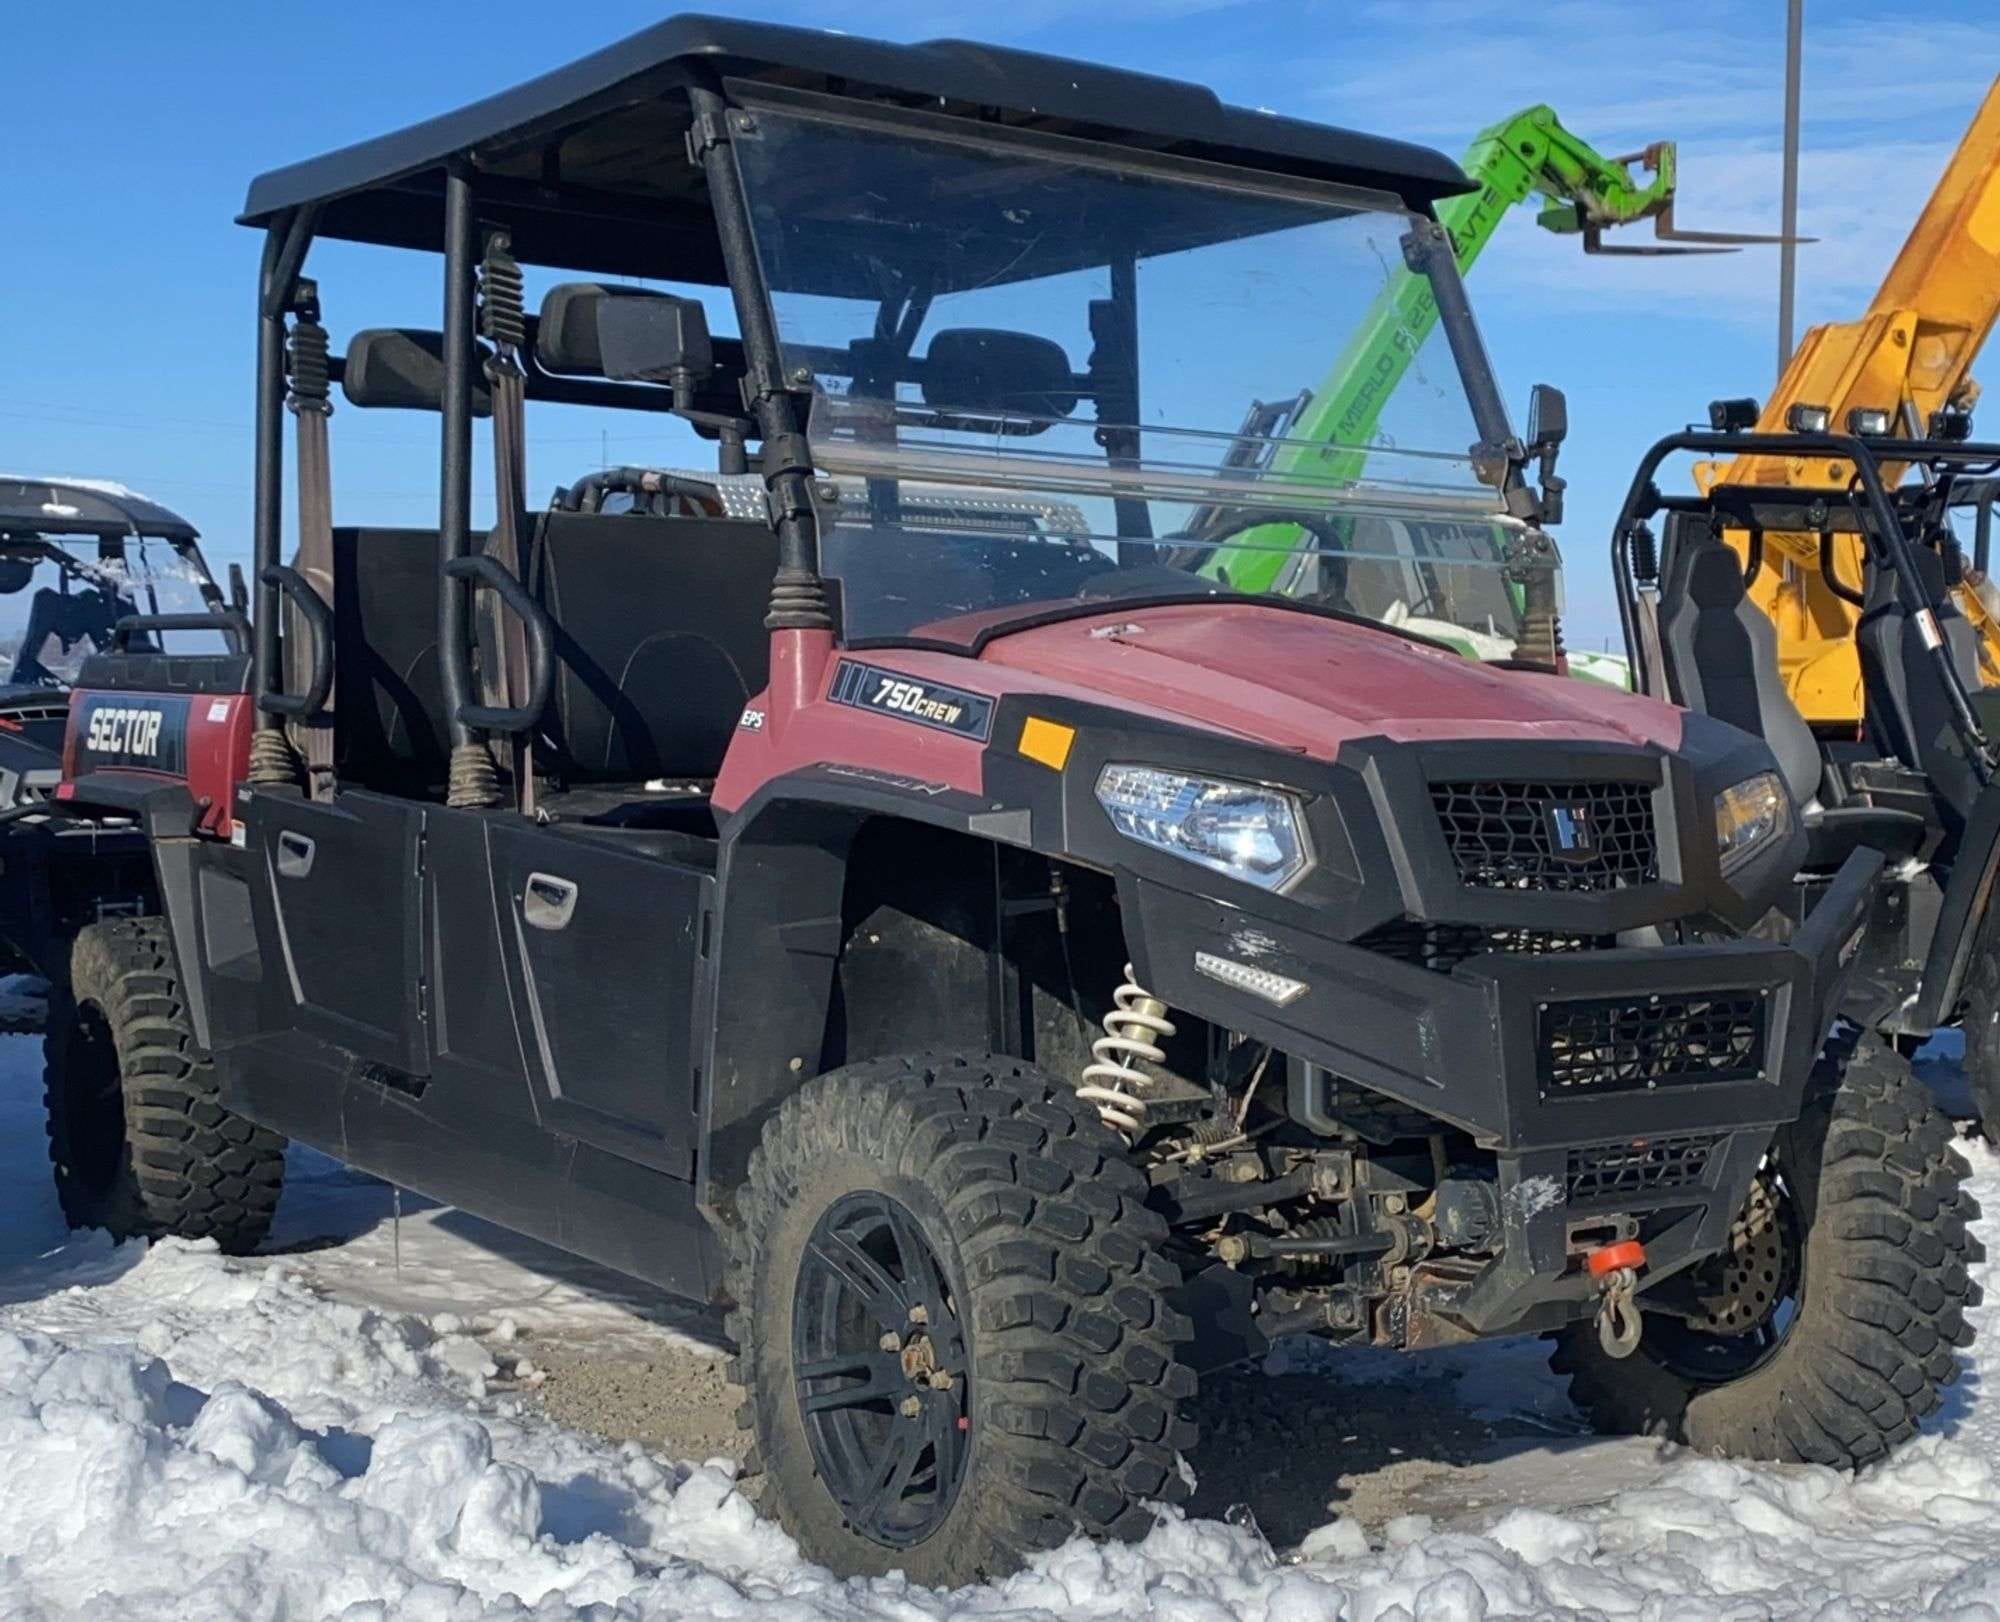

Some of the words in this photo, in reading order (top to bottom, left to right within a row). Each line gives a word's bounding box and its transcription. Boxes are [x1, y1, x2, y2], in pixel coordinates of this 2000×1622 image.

[1338, 352, 1395, 435] MERLO
[87, 707, 164, 757] SECTOR
[740, 710, 766, 728] EPS
